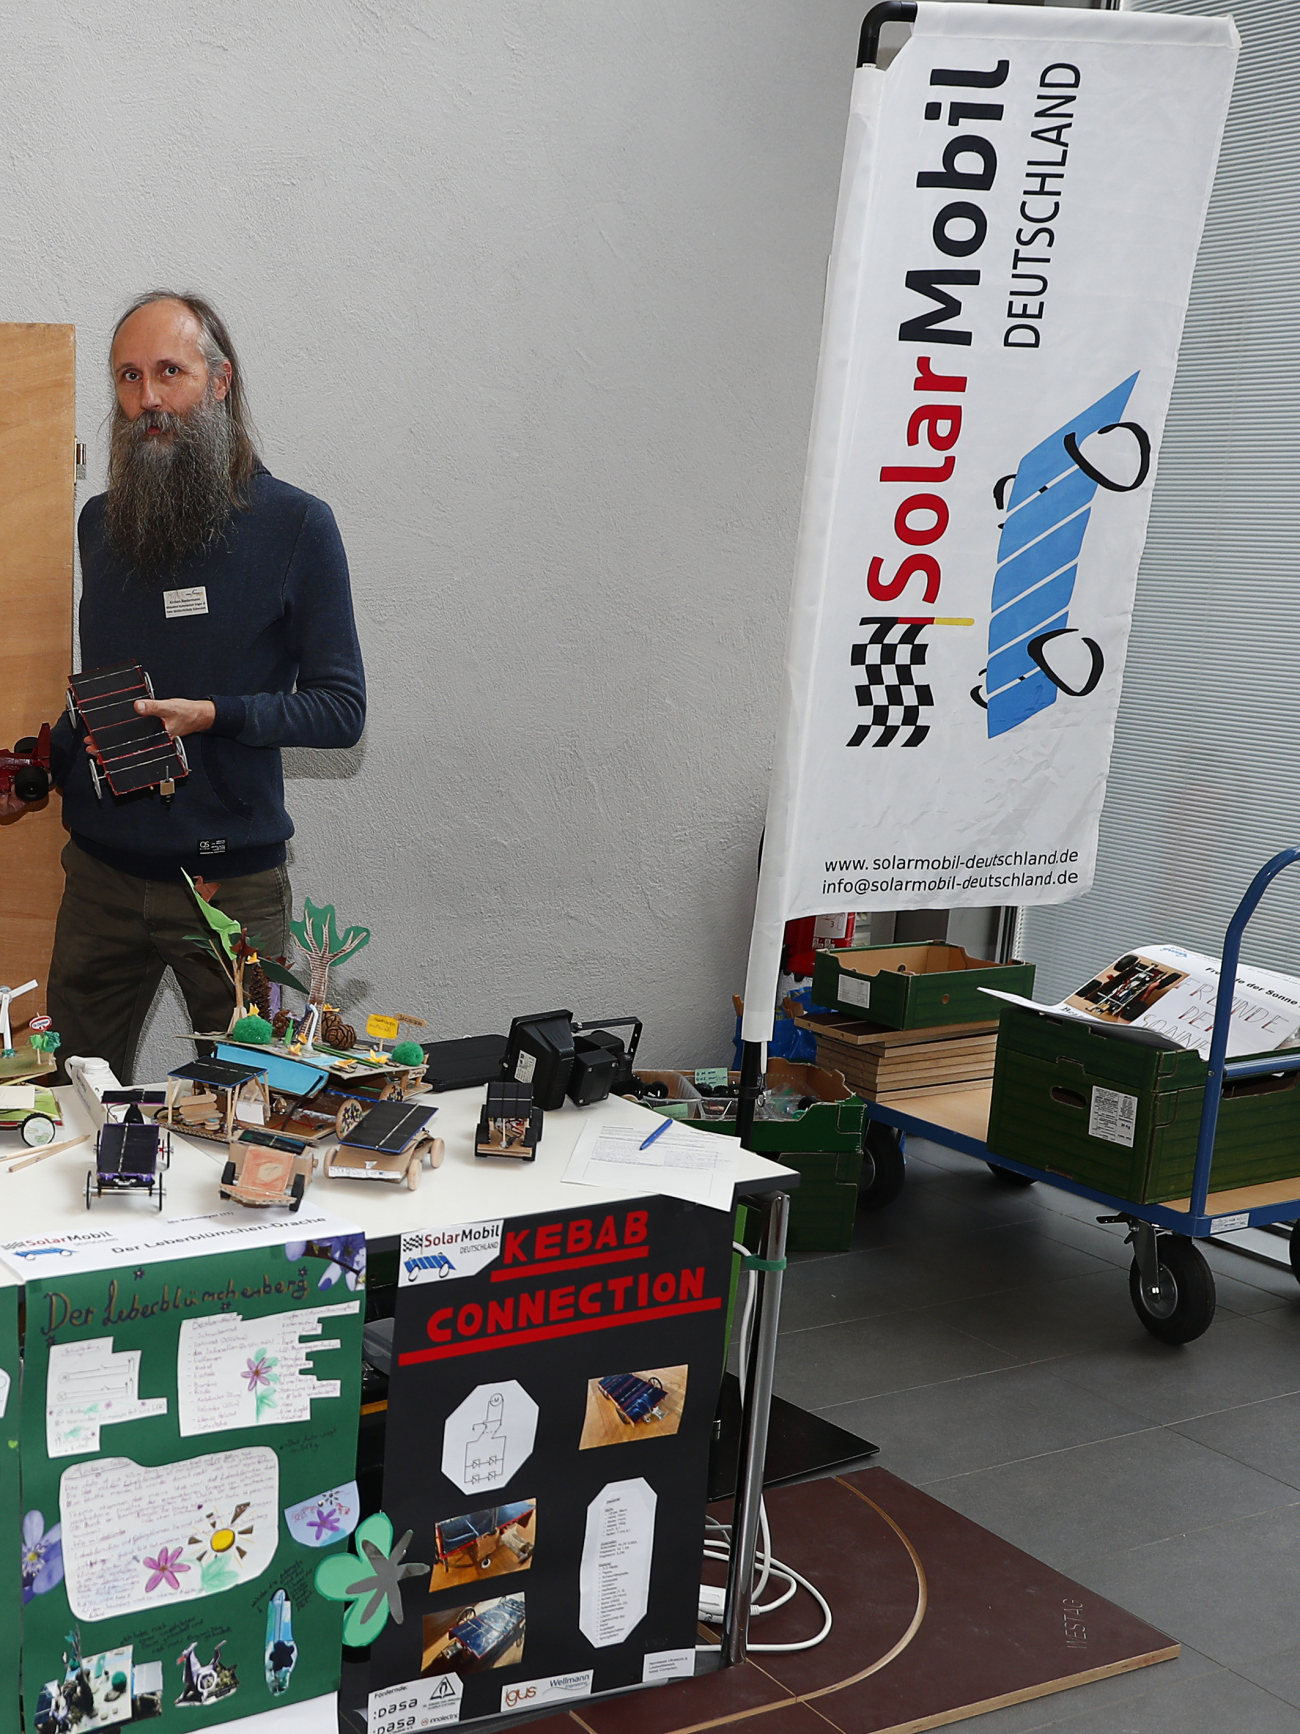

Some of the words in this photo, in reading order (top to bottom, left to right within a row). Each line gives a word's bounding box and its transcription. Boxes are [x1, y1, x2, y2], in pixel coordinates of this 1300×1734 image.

[1004, 62, 1082, 350] DEUTSCHLAND
[867, 59, 1010, 605] SolarMobil
[824, 857, 869, 872] www.
[872, 849, 1079, 871] solarmobil-deutschland.de
[822, 870, 1079, 894] info@solarmobil-deutschland.de
[25, 1230, 114, 1248] SolarMobil
[111, 1243, 140, 1254] Der
[146, 1216, 327, 1249] Leberblümchen-Drache
[424, 1224, 500, 1248] SolarMobil
[459, 1241, 499, 1254] DEUTSCHLAND
[503, 1210, 649, 1265] KEBAB
[40, 1291, 96, 1338] Der
[426, 1267, 705, 1342] CONNECTION
[1062, 1598, 1088, 1649] WESTAG
[505, 1685, 537, 1707] igus
[550, 1673, 590, 1688] Wellmann
